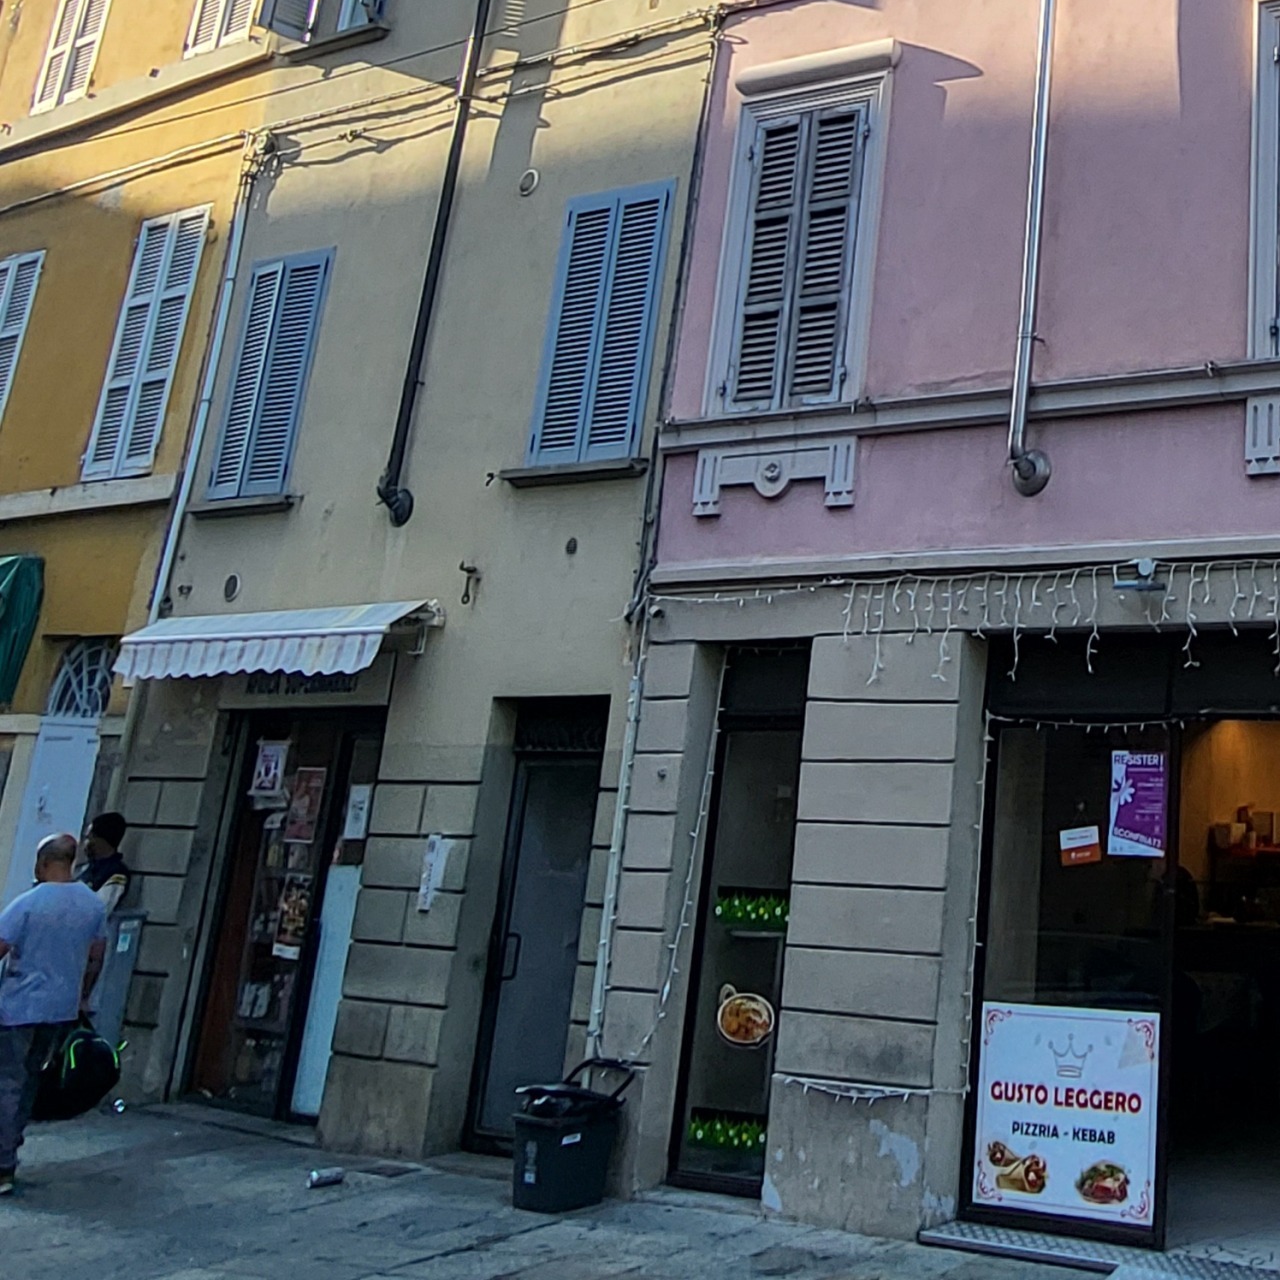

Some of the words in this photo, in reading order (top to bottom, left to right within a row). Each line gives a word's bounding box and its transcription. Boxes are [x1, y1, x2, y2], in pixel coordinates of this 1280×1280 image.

[990, 1081, 1048, 1105] GUSTO
[1053, 1086, 1142, 1113] LEGGERO
[1012, 1121, 1060, 1139] PIZZRIA
[1072, 1127, 1116, 1145] KEBAB
